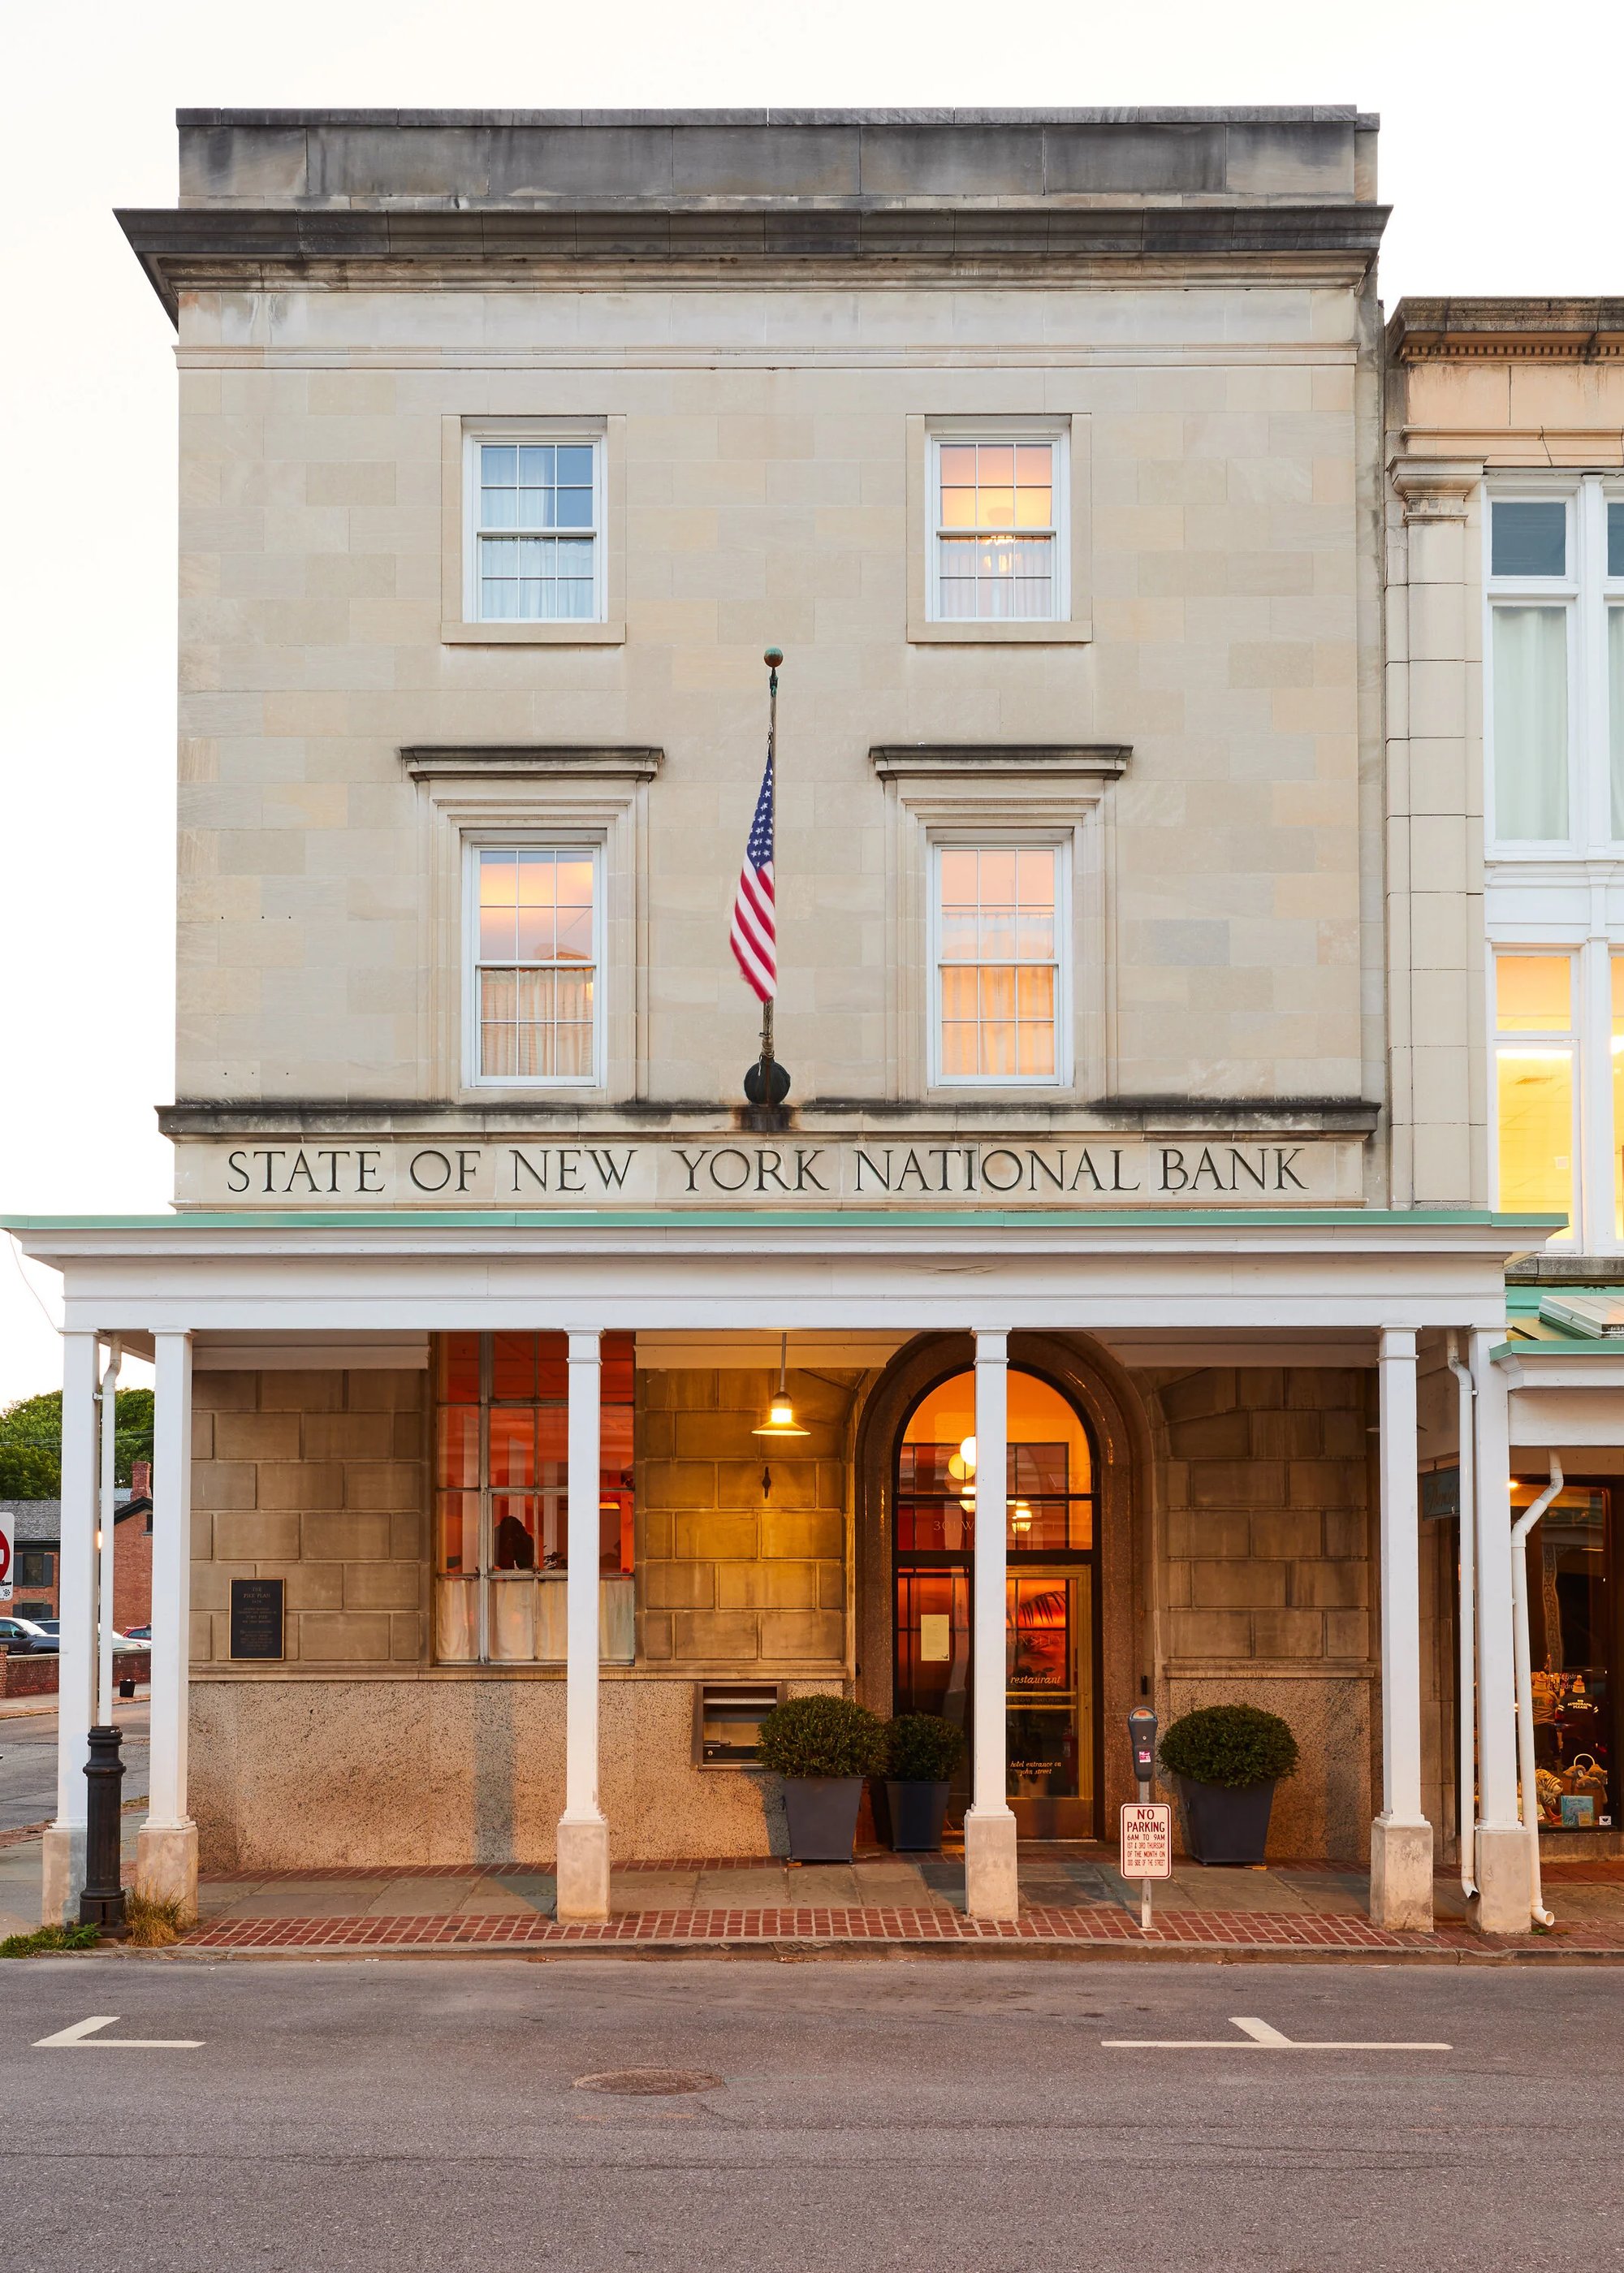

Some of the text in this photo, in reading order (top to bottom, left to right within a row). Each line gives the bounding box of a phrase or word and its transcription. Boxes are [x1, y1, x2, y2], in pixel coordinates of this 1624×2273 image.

[227, 1146, 1310, 1193] STATE OF NEW YORK NATIONAL BANK
[1010, 1675, 1061, 1684] restaurant
[1020, 1768, 1033, 1776] john
[1137, 1808, 1155, 1820] NO
[1127, 1821, 1165, 1832] PARKING
